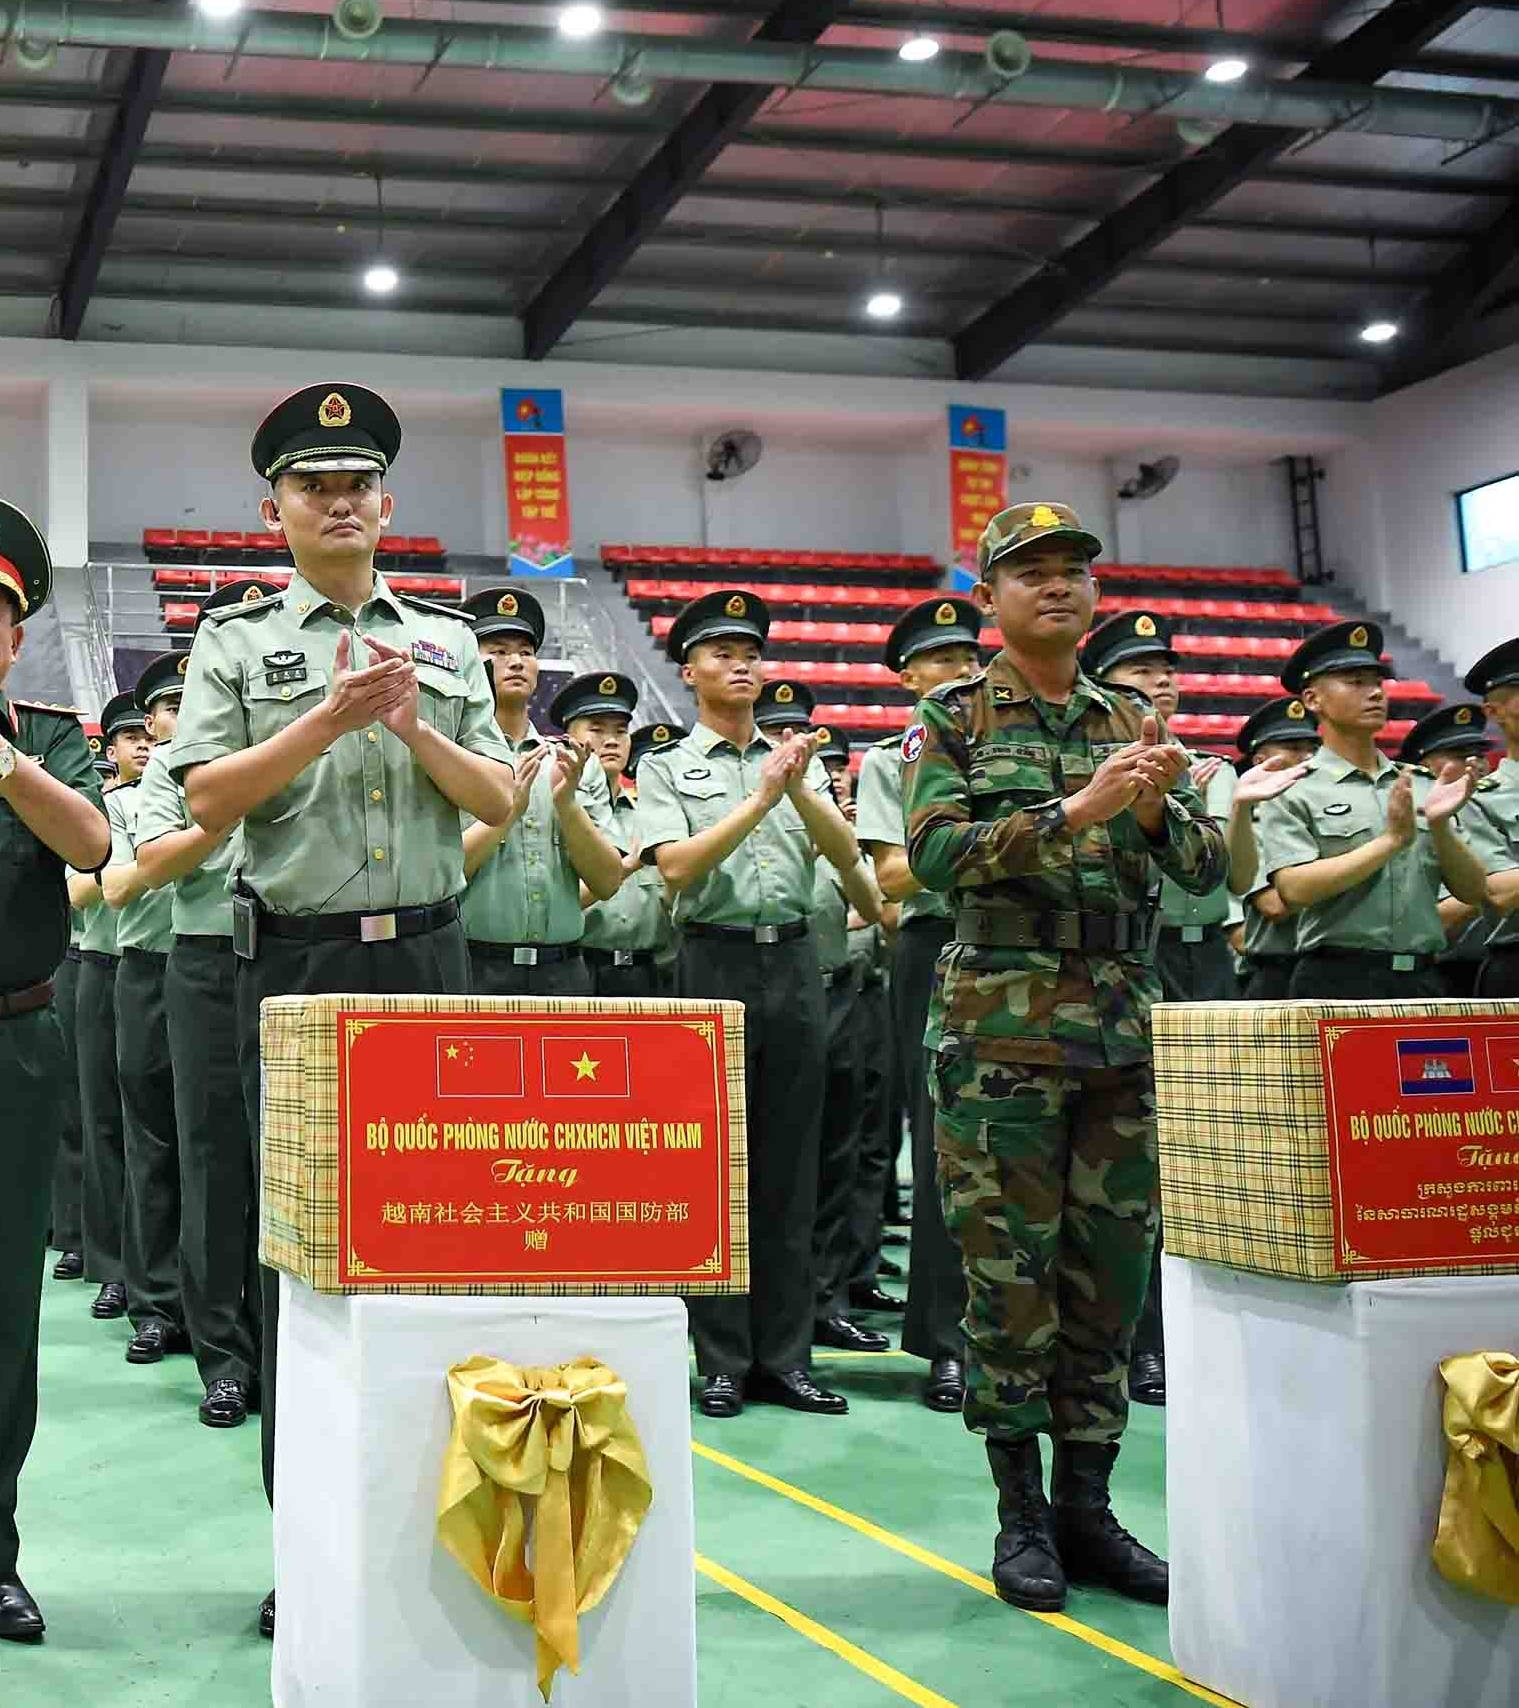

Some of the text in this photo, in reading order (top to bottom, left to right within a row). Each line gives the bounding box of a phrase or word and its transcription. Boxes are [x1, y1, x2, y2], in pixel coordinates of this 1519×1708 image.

[366, 1111, 702, 1157] BỘ QUỐC PHÒNG NƯỚC CHXHCN VIỆT NAM
[1350, 1104, 1519, 1146] BỘ QUỐC PHÒNG NƯỚC C
[1457, 1145, 1519, 1171] Tặn
[490, 1158, 578, 1188] Tặng
[381, 1200, 690, 1225] 越南社会主义共和国国防部
[524, 1228, 549, 1253] 赠
